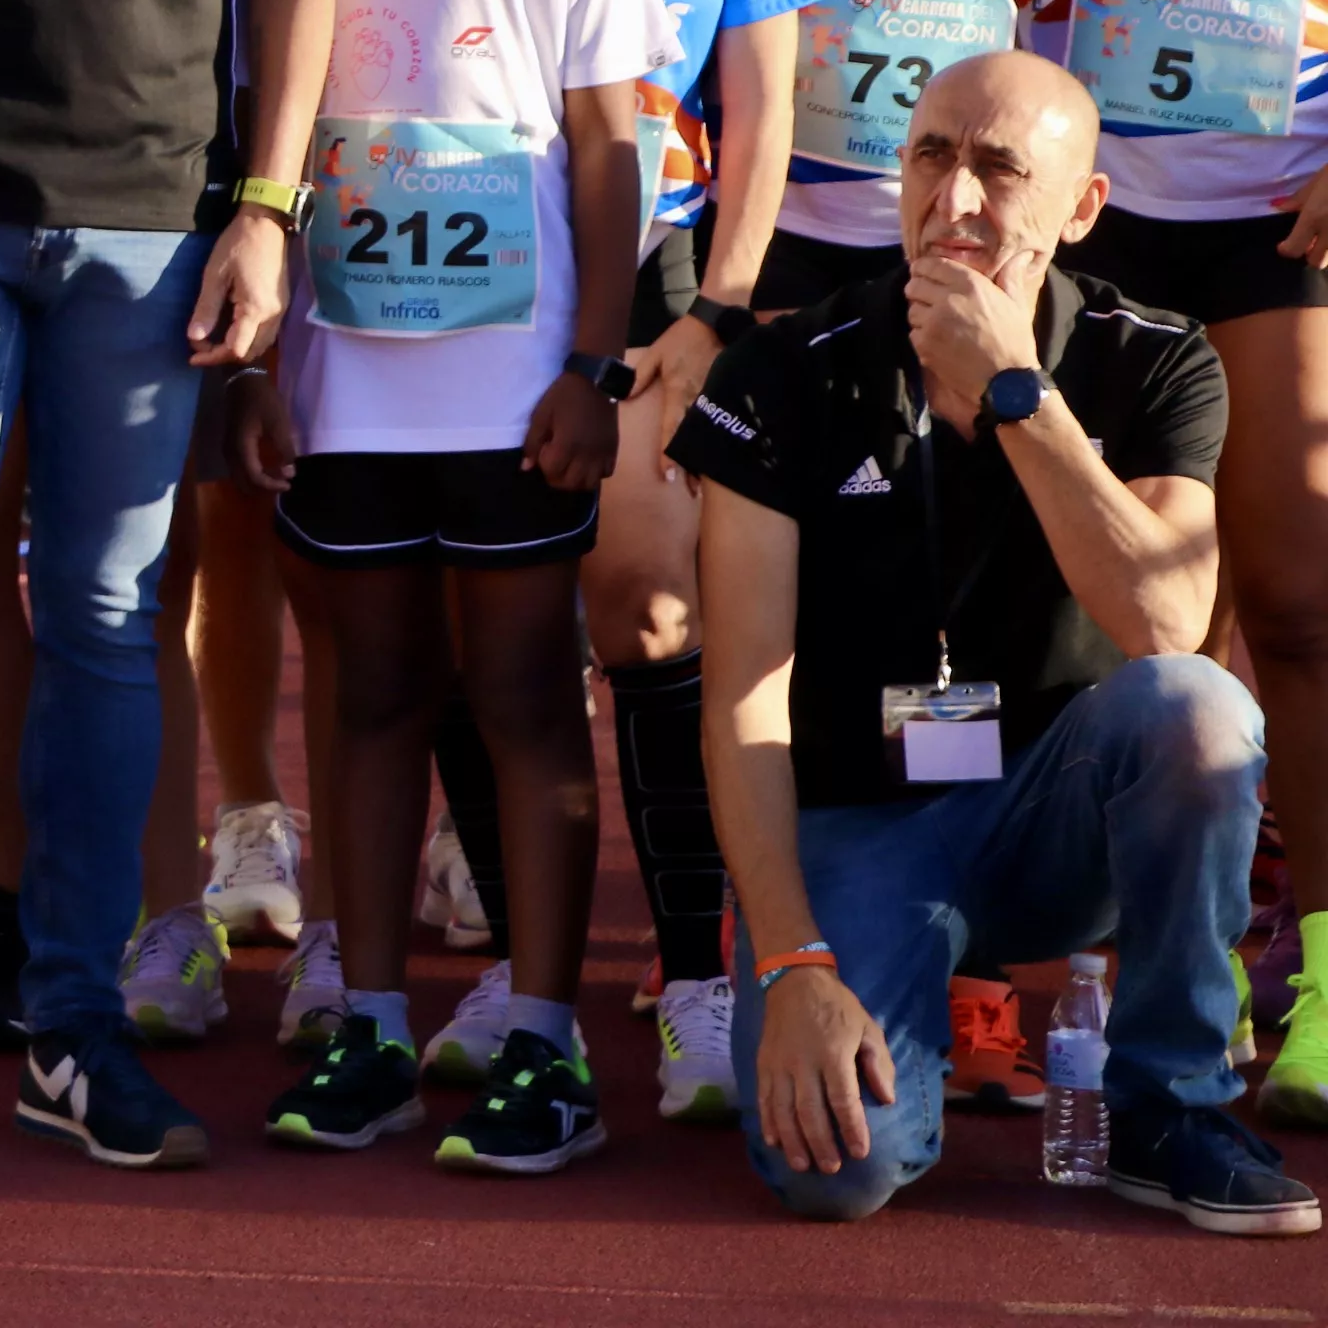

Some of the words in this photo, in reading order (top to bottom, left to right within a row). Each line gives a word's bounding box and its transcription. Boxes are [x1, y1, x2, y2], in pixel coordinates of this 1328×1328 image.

[382, 8, 397, 20] TU
[968, 2, 997, 21] DEL
[1256, 4, 1286, 21] DEL
[847, 50, 933, 109] 73
[1148, 46, 1194, 102] 5
[881, 114, 909, 126] DIAZ
[1104, 98, 1146, 116] MARIBEL
[1149, 107, 1174, 119] RUIZ
[1176, 112, 1233, 128] PACHECO
[396, 147, 417, 168] IV
[416, 151, 483, 168] CARRERA
[345, 208, 490, 267] 212
[344, 273, 383, 284] THIAGO
[386, 275, 435, 286] ROMERO
[438, 276, 491, 286] RIASCOS
[381, 302, 441, 320] Infrico
[407, 297, 439, 307] GRUPO
[838, 479, 892, 495] adidas
